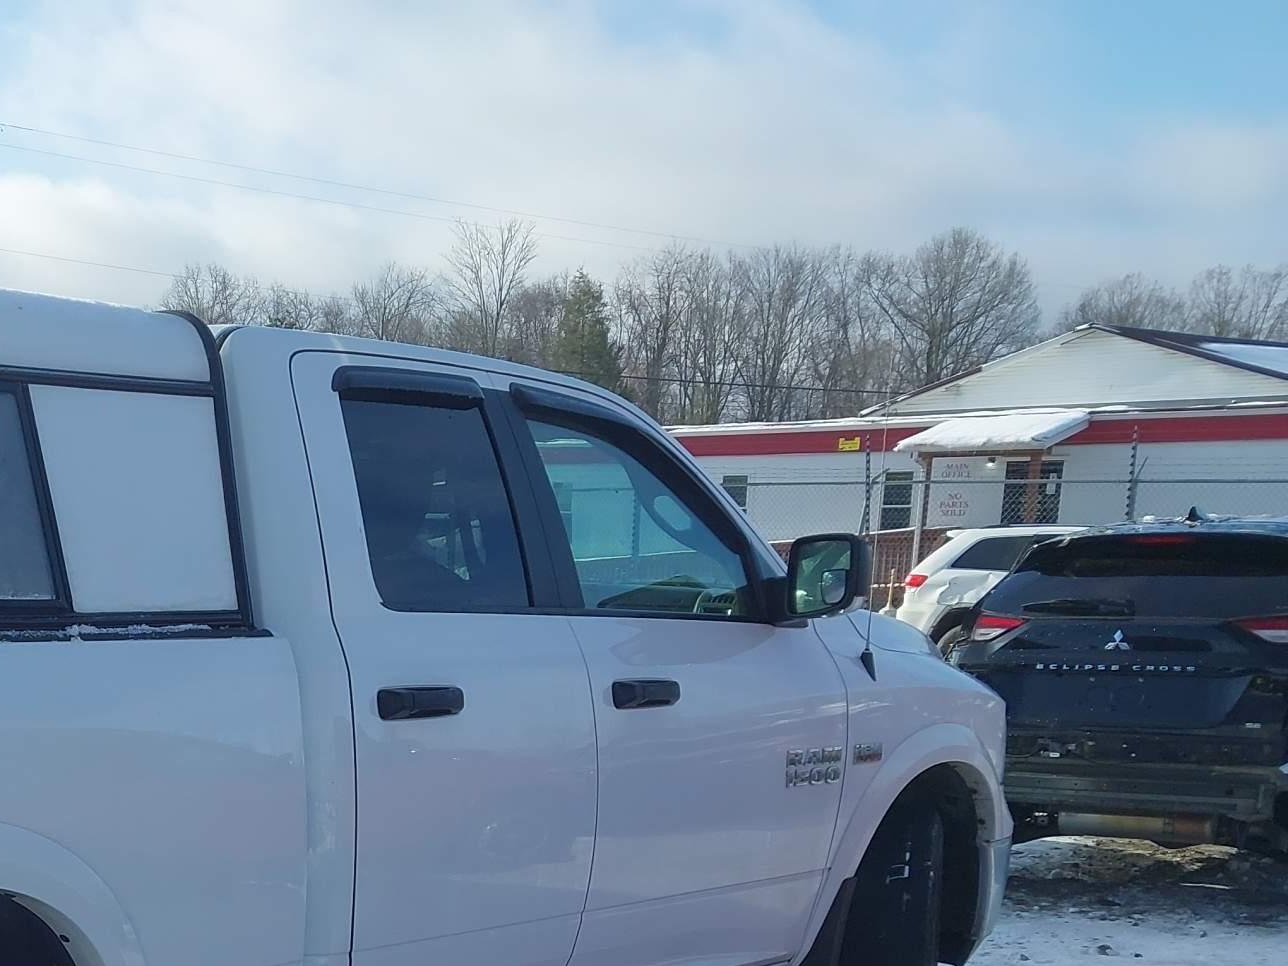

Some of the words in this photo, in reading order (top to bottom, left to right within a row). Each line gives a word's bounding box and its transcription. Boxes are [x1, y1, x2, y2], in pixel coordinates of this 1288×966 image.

[946, 462, 970, 470] MAIN
[941, 470, 971, 479] OFFICE
[947, 492, 963, 501] NO
[939, 501, 969, 509] PARTS
[941, 509, 966, 517] SOLD
[1035, 663, 1120, 671] ECLIPSE
[786, 747, 842, 767] RAM
[785, 766, 841, 788] 1500
